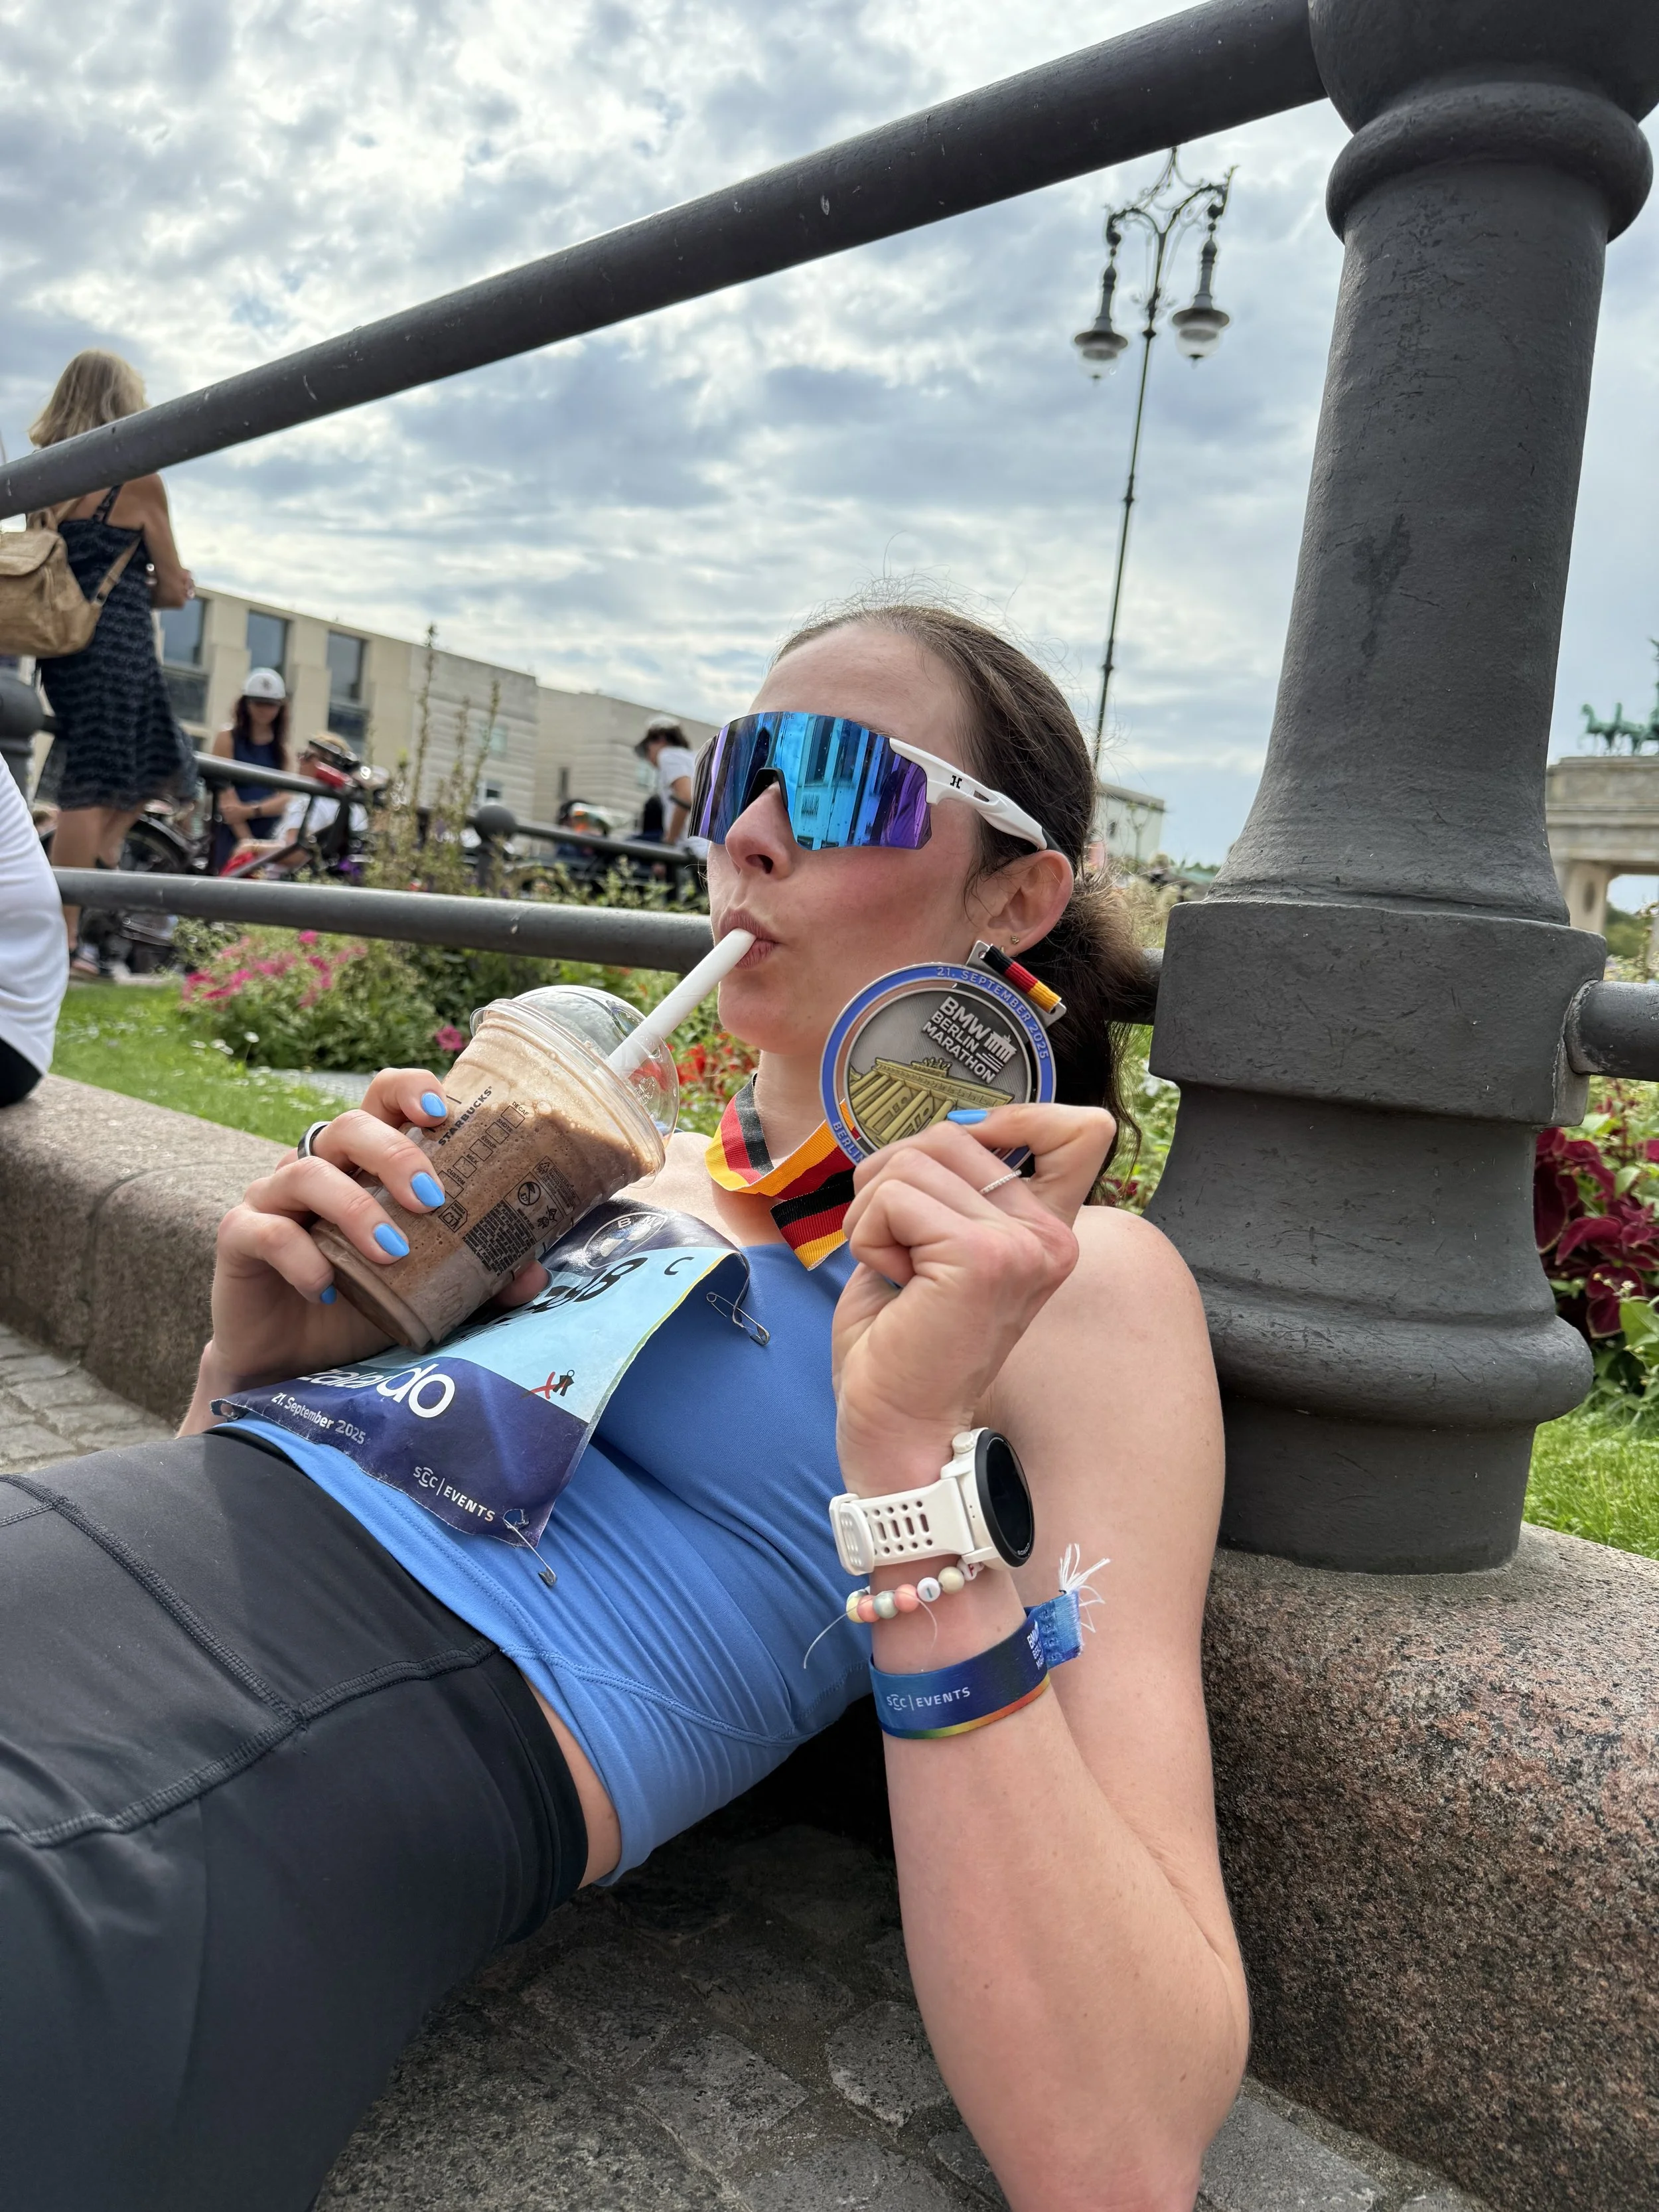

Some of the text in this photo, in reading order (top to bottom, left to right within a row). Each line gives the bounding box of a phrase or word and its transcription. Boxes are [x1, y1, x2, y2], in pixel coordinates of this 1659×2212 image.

[931, 1010, 980, 1053] BERLIN
[936, 967, 1049, 1059] 21. SEPTEMBER 2025
[939, 996, 991, 1041] BMW
[922, 1021, 996, 1084] MARATHON
[512, 1101, 529, 1116] DECAF
[466, 1153, 479, 1165] MILK
[480, 1135, 497, 1149] SYRUP
[447, 1168, 466, 1185] CUSTOM
[271, 1392, 366, 1445] 21. September 2025
[443, 1485, 496, 1522] EVENTS
[916, 1686, 970, 1708] EVENTS
